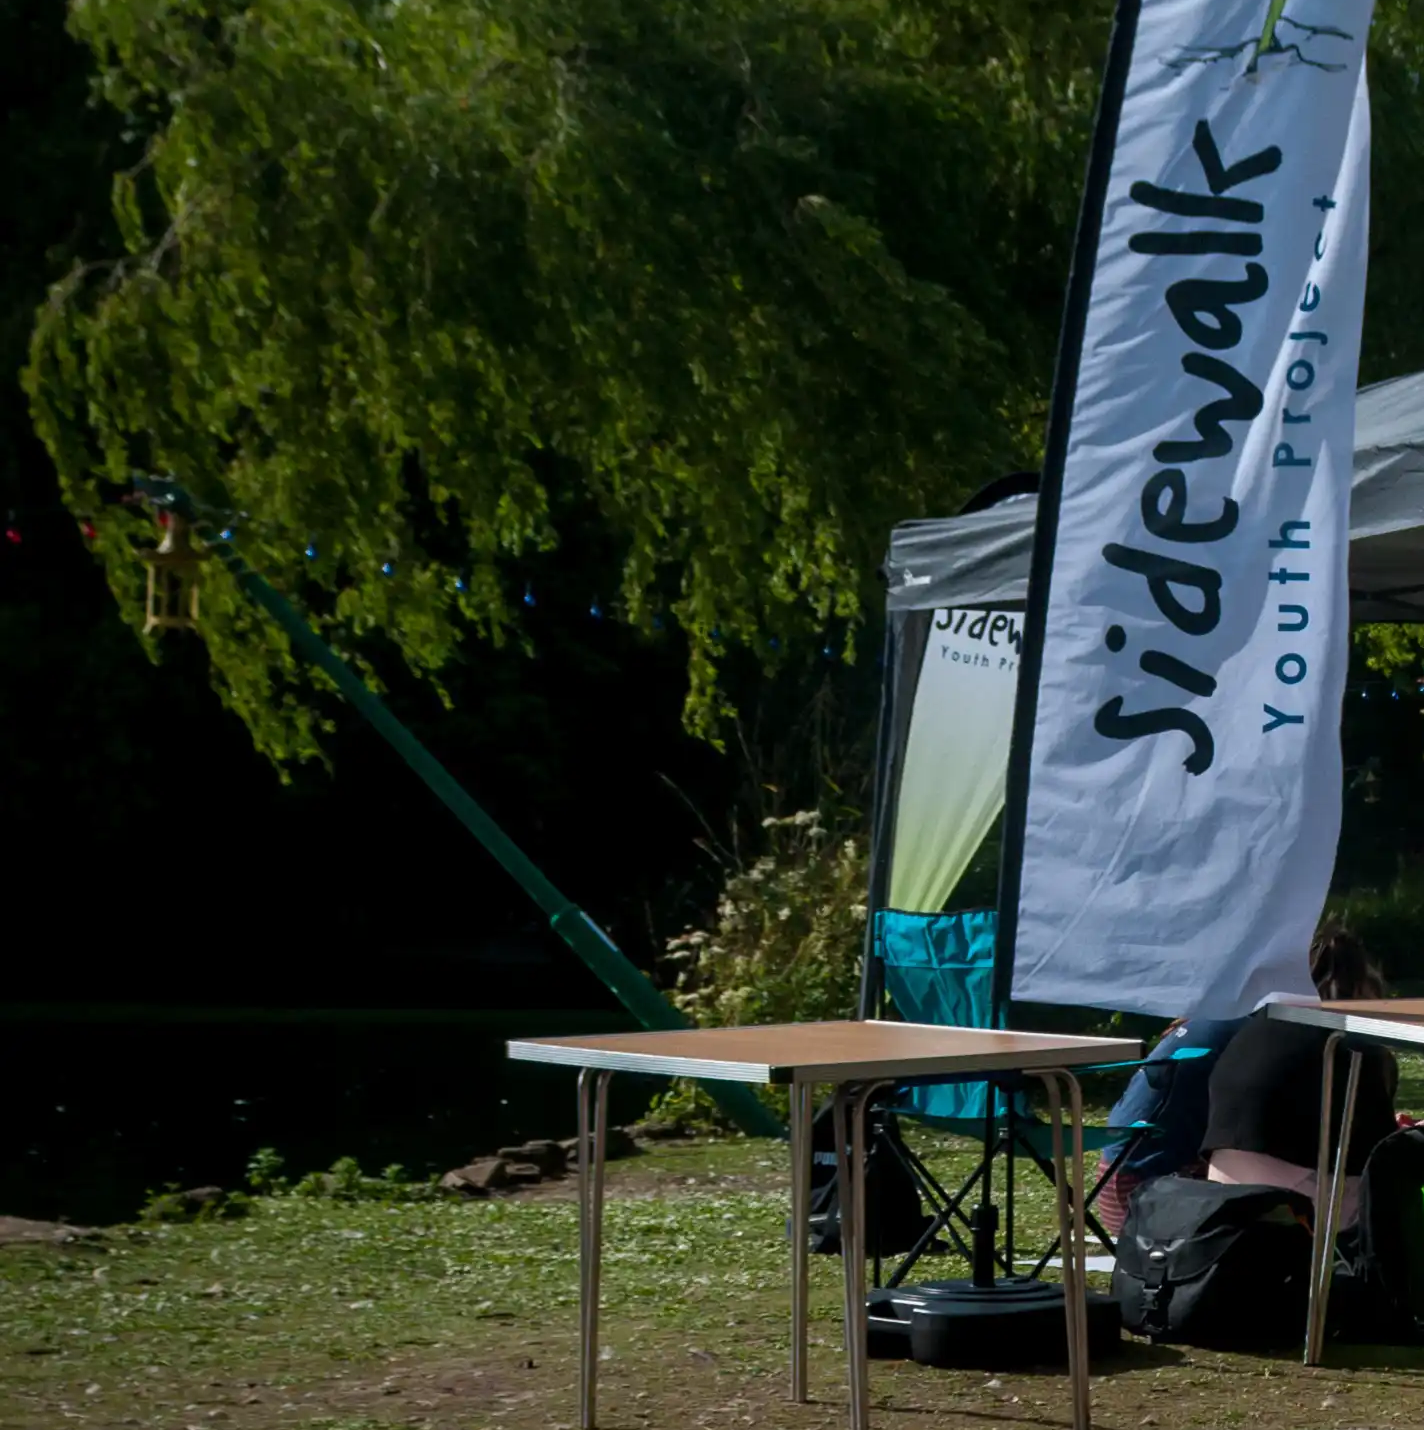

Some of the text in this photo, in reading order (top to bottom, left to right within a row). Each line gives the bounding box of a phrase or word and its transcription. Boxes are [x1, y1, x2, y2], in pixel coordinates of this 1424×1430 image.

[941, 644, 990, 668] Youth
[1093, 118, 1283, 777] Sidewalk
[1262, 194, 1337, 734] Youth Project
